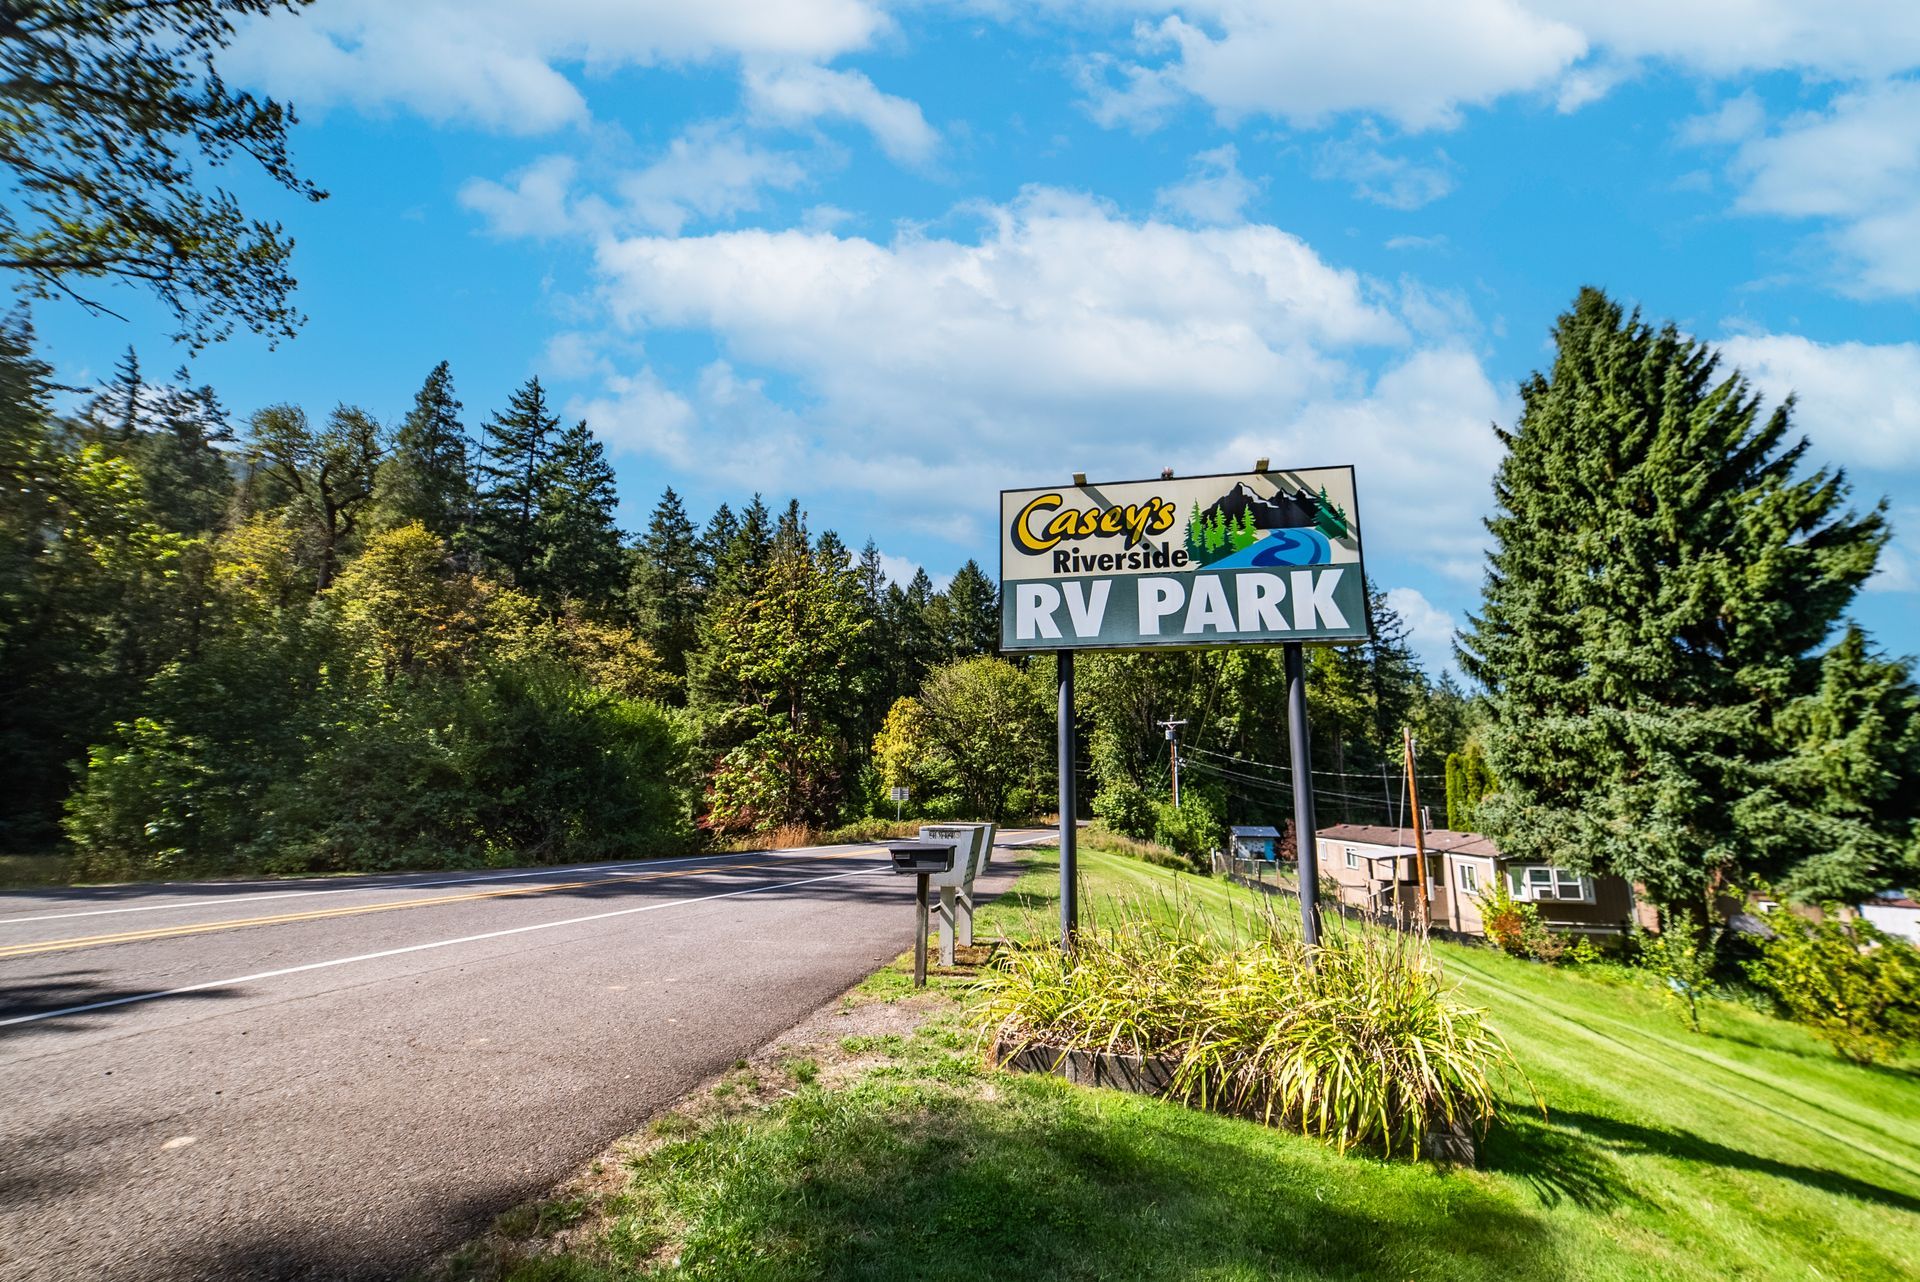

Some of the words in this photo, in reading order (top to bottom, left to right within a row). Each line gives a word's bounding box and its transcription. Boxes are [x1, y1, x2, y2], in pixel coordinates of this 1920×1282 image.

[1011, 493, 1176, 556] Casey's
[1053, 541, 1189, 574] Riverside
[1016, 579, 1112, 640] RV
[1137, 568, 1350, 636] PARK
